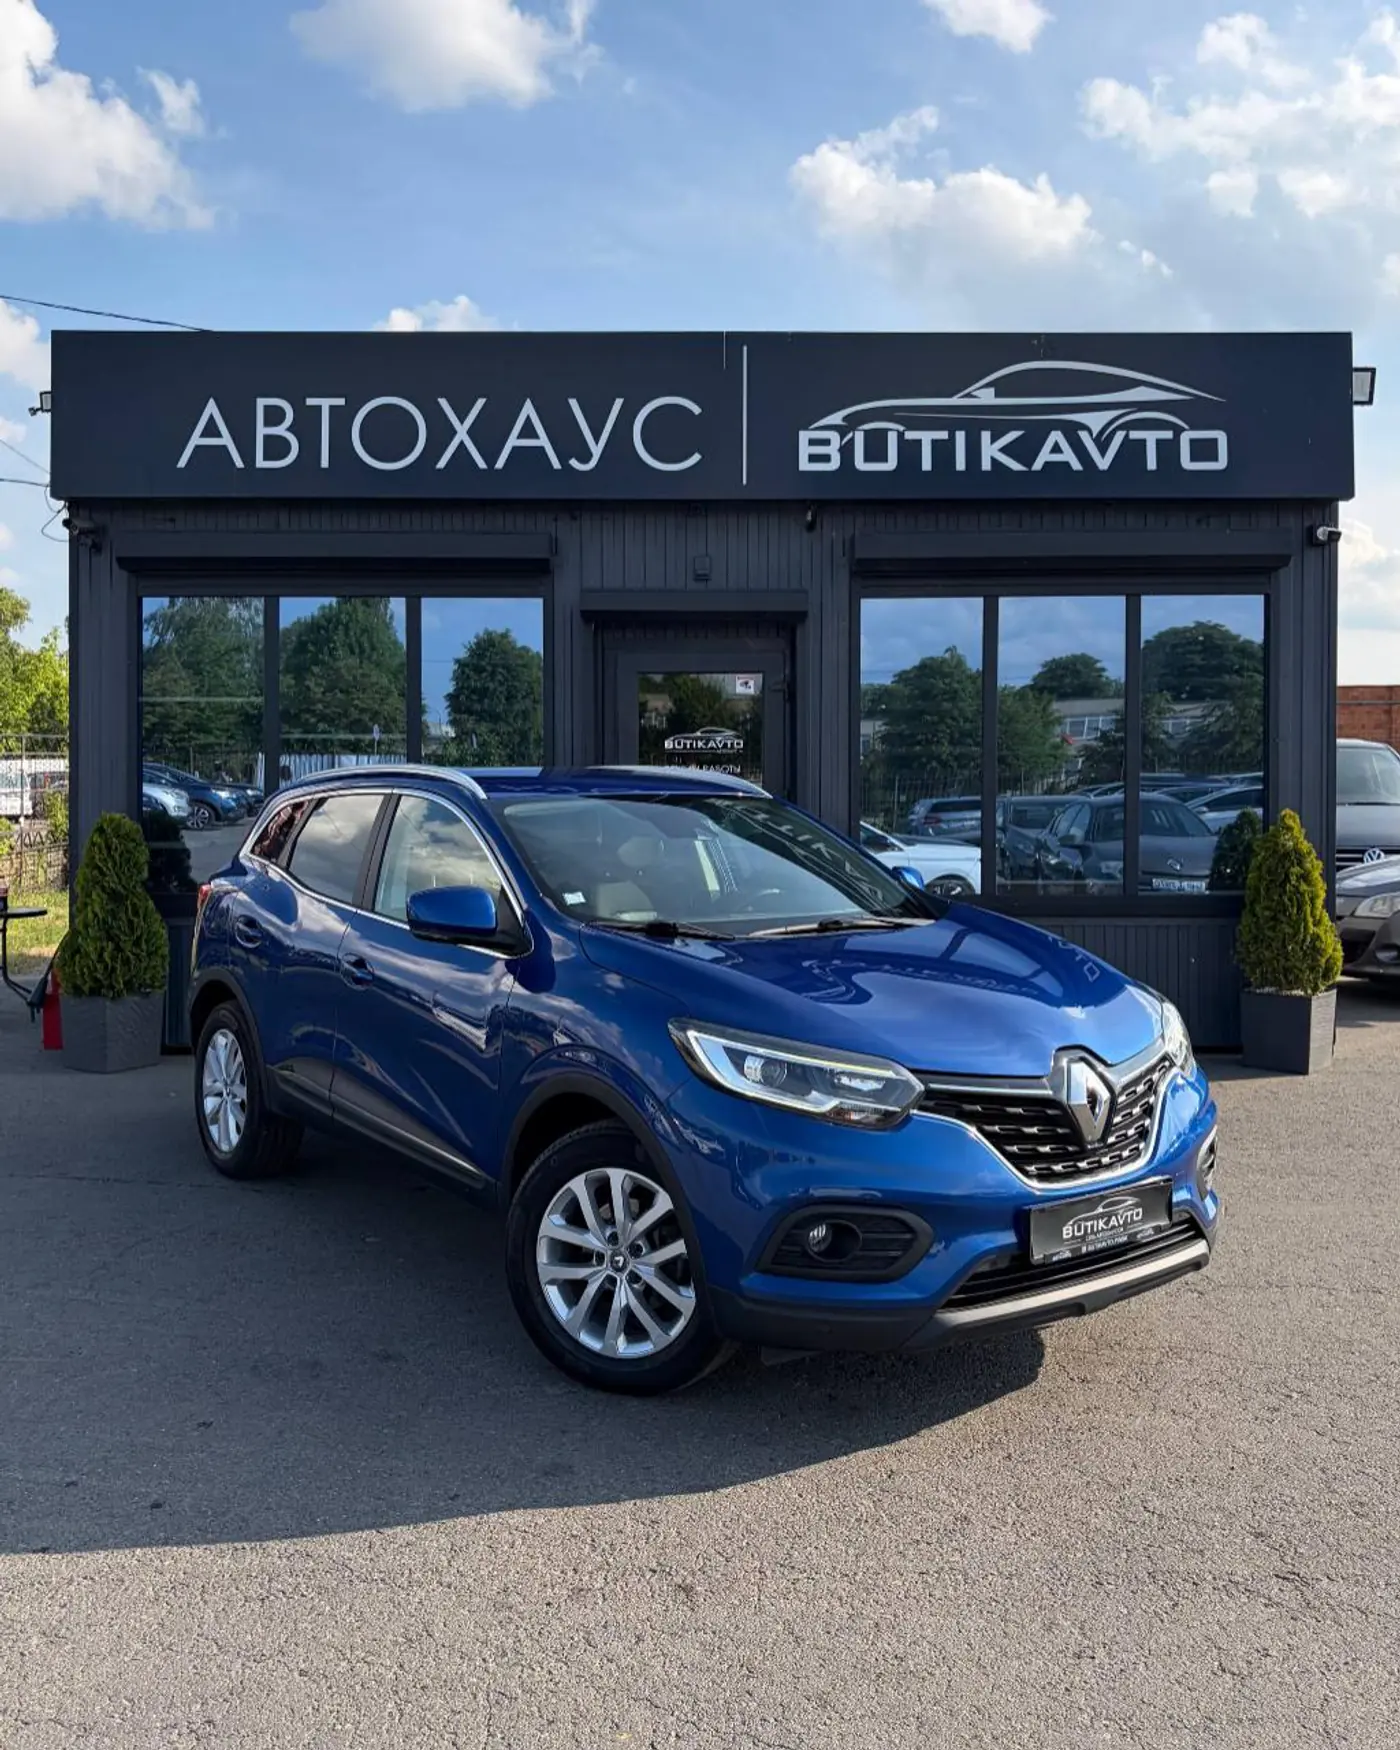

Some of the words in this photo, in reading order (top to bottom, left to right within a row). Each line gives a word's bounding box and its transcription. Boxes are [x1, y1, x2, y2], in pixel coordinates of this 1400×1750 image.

[177, 397, 702, 472] АВТОХАУС
[798, 430, 1228, 472] BUTIKAVTO
[664, 739, 744, 750] BUTIKAVTO
[1062, 1207, 1143, 1239] BUTIKAVTO
